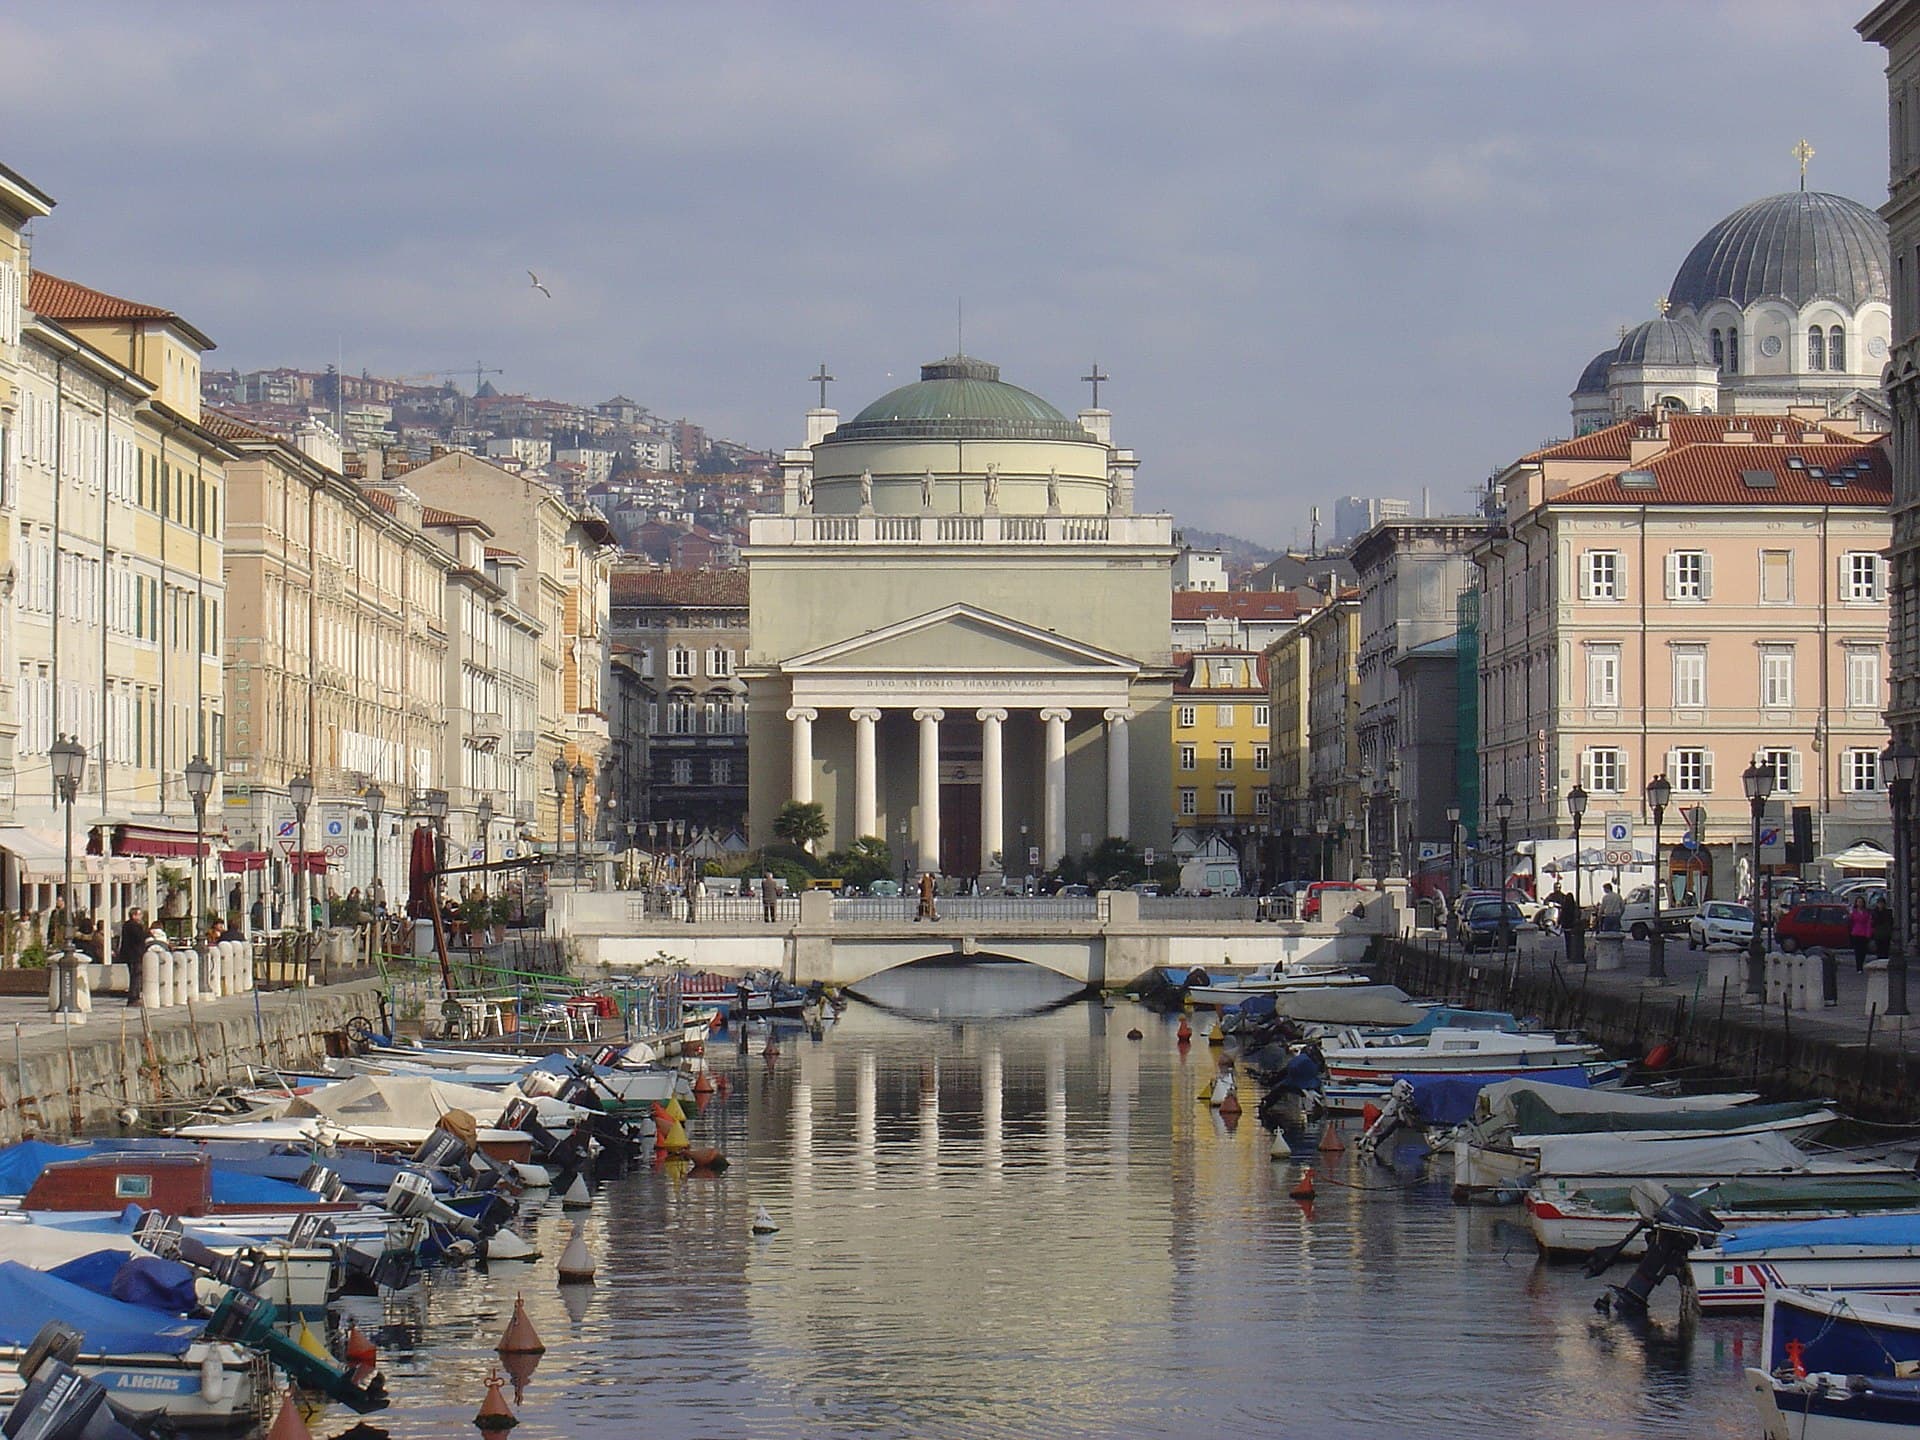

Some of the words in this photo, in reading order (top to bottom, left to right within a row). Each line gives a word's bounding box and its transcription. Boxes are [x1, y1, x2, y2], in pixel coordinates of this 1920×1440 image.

[867, 679, 896, 688] DIVO
[903, 679, 954, 688] ANTONIO
[116, 1374, 181, 1391] A.Hellas
[40, 1373, 73, 1413] YAMAHA
